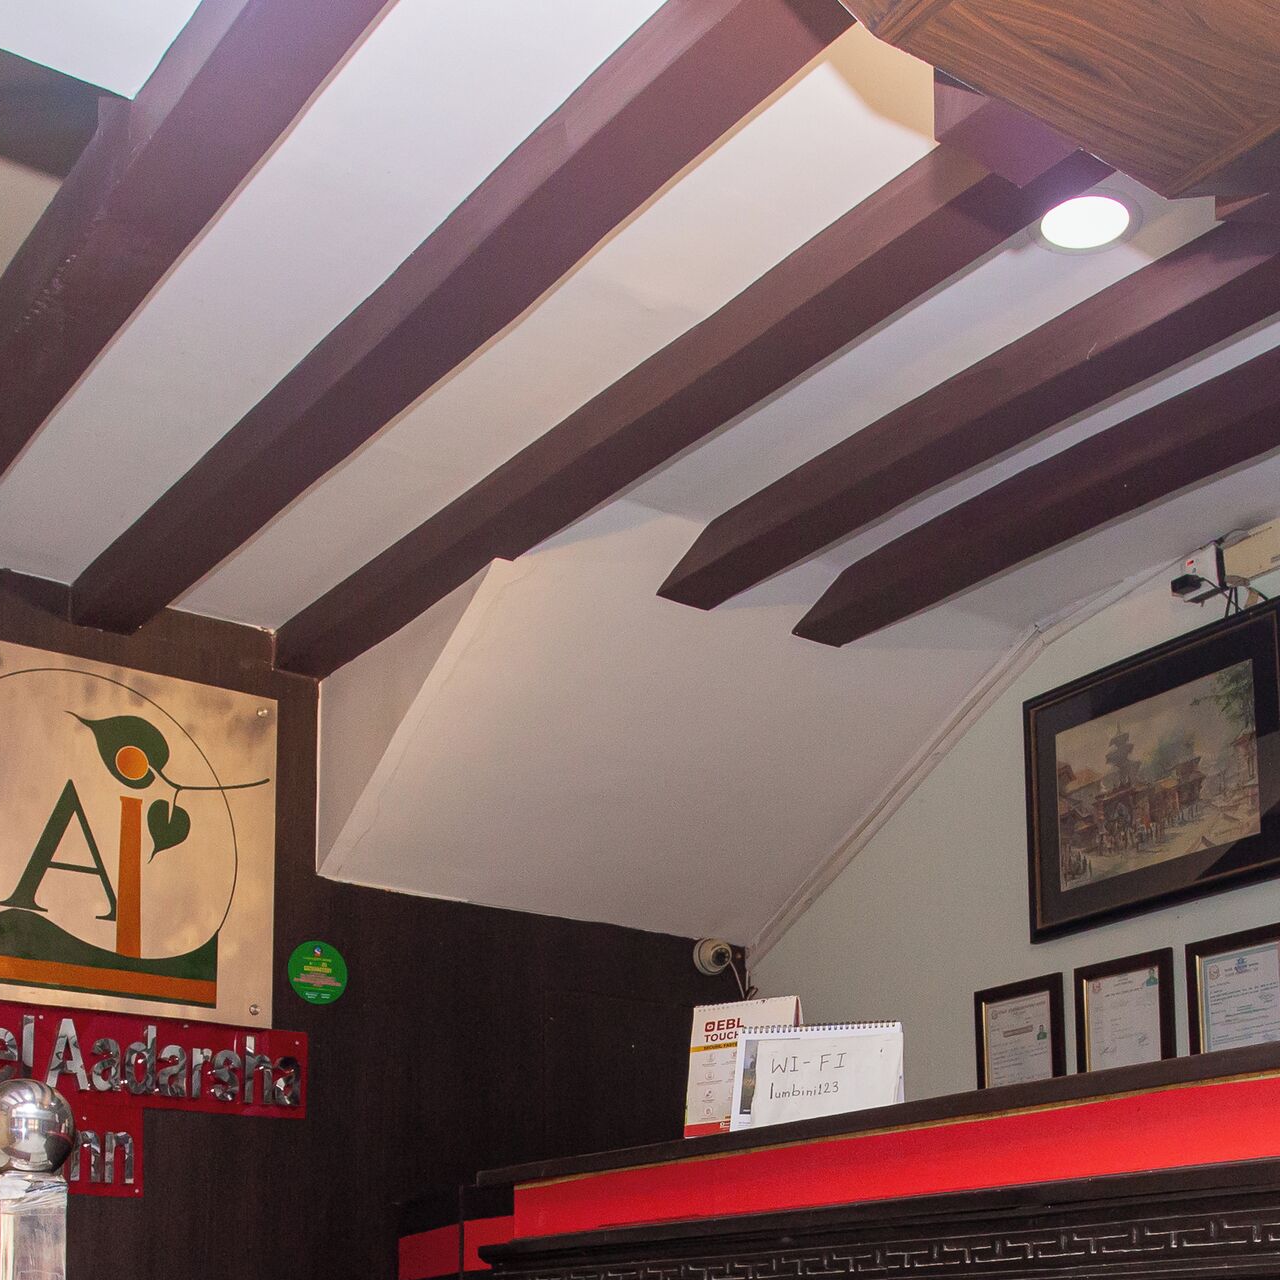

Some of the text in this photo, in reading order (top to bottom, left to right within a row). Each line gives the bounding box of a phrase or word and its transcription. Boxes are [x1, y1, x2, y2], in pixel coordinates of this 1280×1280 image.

[717, 1018, 744, 1030] EBL
[46, 1018, 301, 1106] Aadarsha
[63, 1130, 135, 1184] nn
